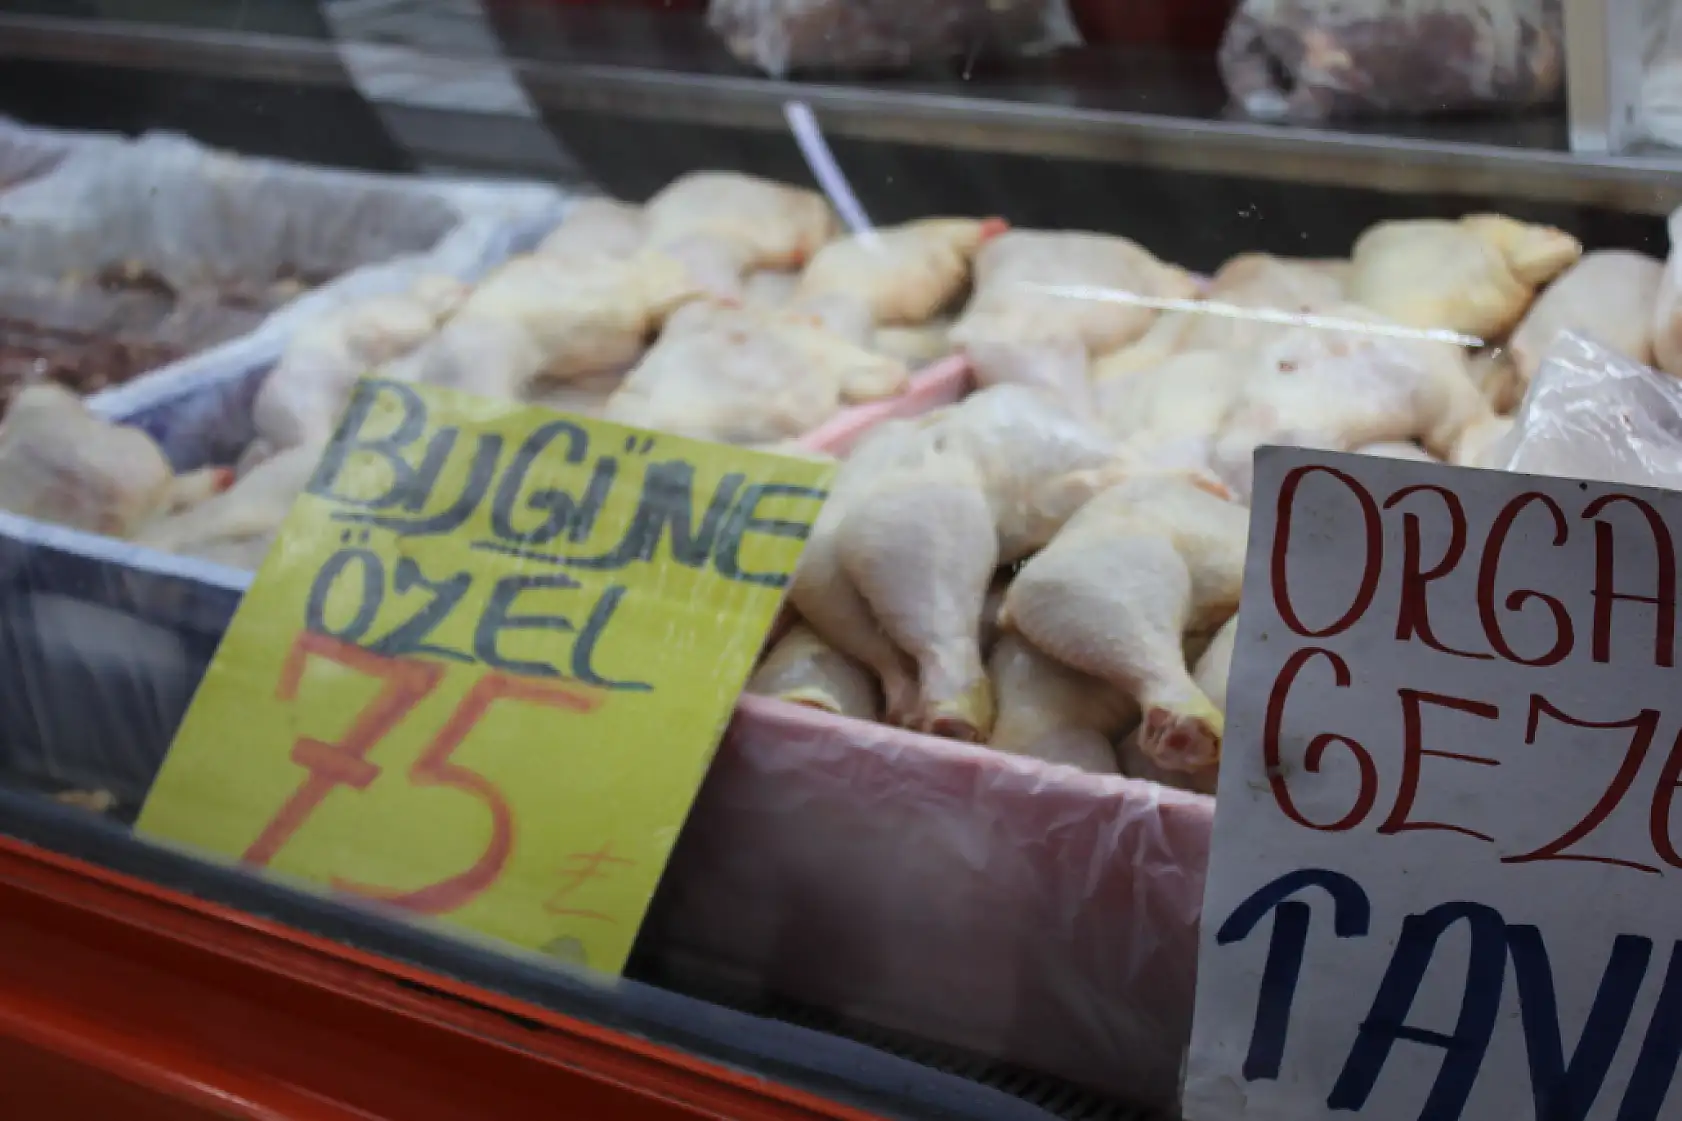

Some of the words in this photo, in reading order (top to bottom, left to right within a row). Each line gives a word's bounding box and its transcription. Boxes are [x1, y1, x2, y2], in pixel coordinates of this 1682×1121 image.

[305, 375, 831, 588] BUGÜNE
[305, 529, 654, 691] ÖZEL
[240, 630, 602, 916] 75
